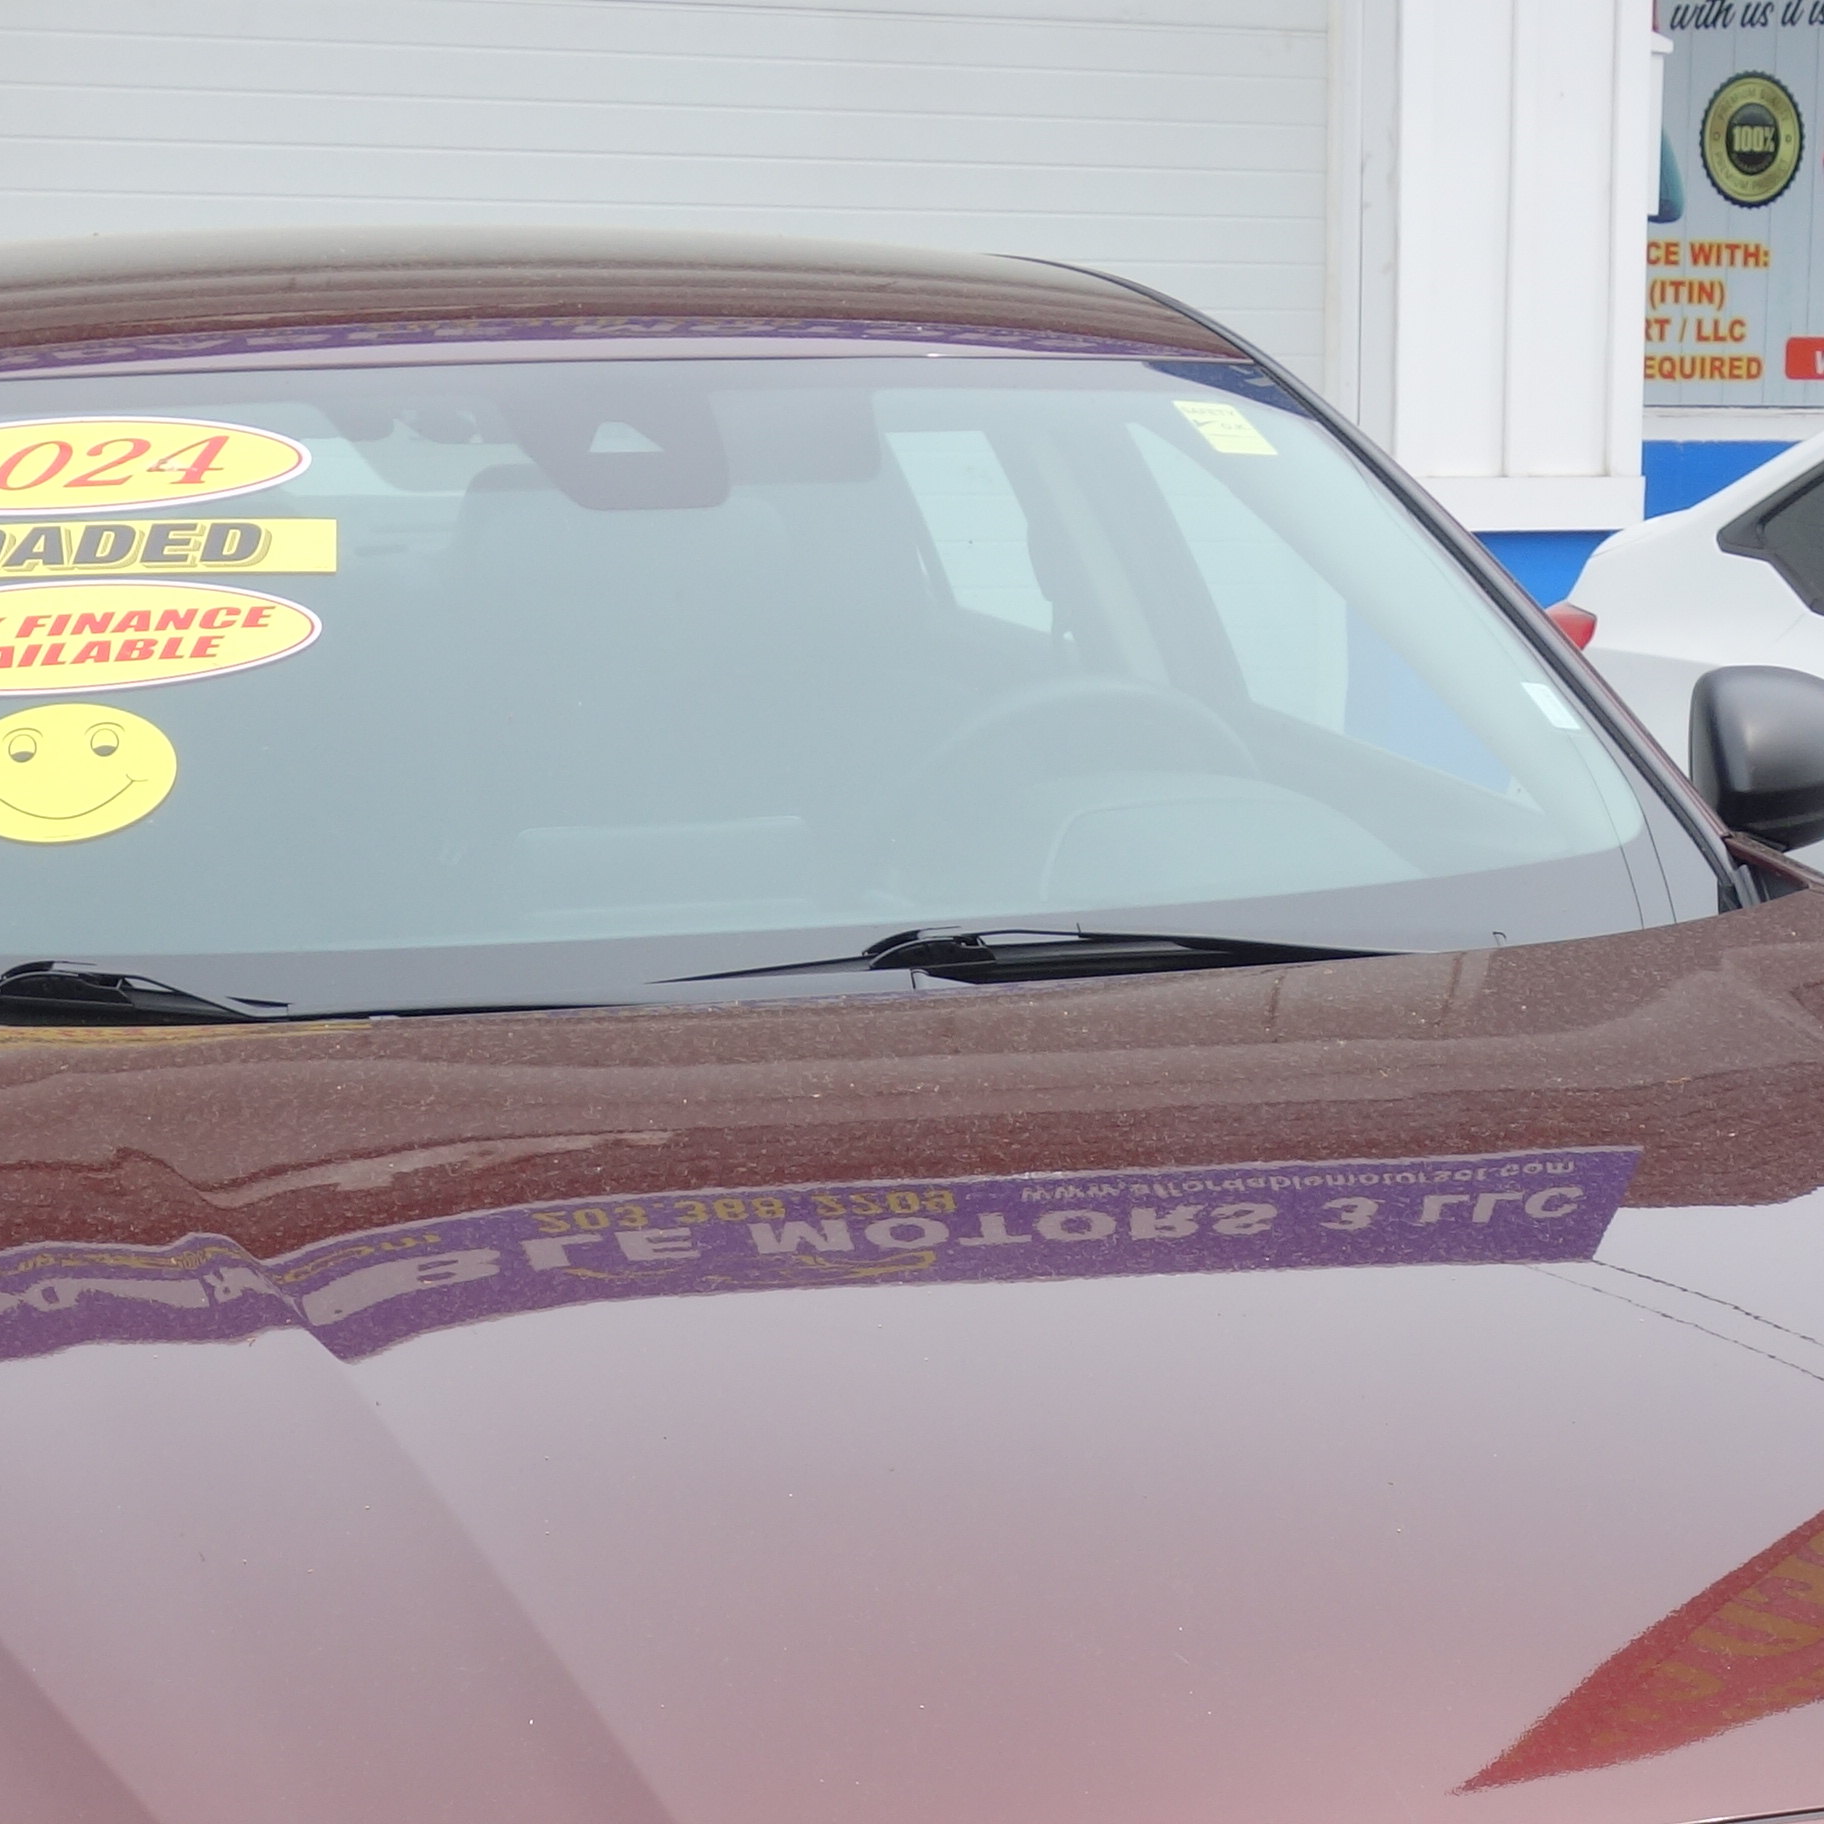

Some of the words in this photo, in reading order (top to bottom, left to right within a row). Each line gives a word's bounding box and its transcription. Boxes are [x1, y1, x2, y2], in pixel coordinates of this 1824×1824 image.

[1740, 1, 1774, 28] us
[1733, 125, 1775, 152] 100%
[1690, 242, 1770, 268] WITH:
[1649, 280, 1725, 311] (ITIN)
[1696, 318, 1747, 342] LLC
[14, 604, 276, 639] FINANCE
